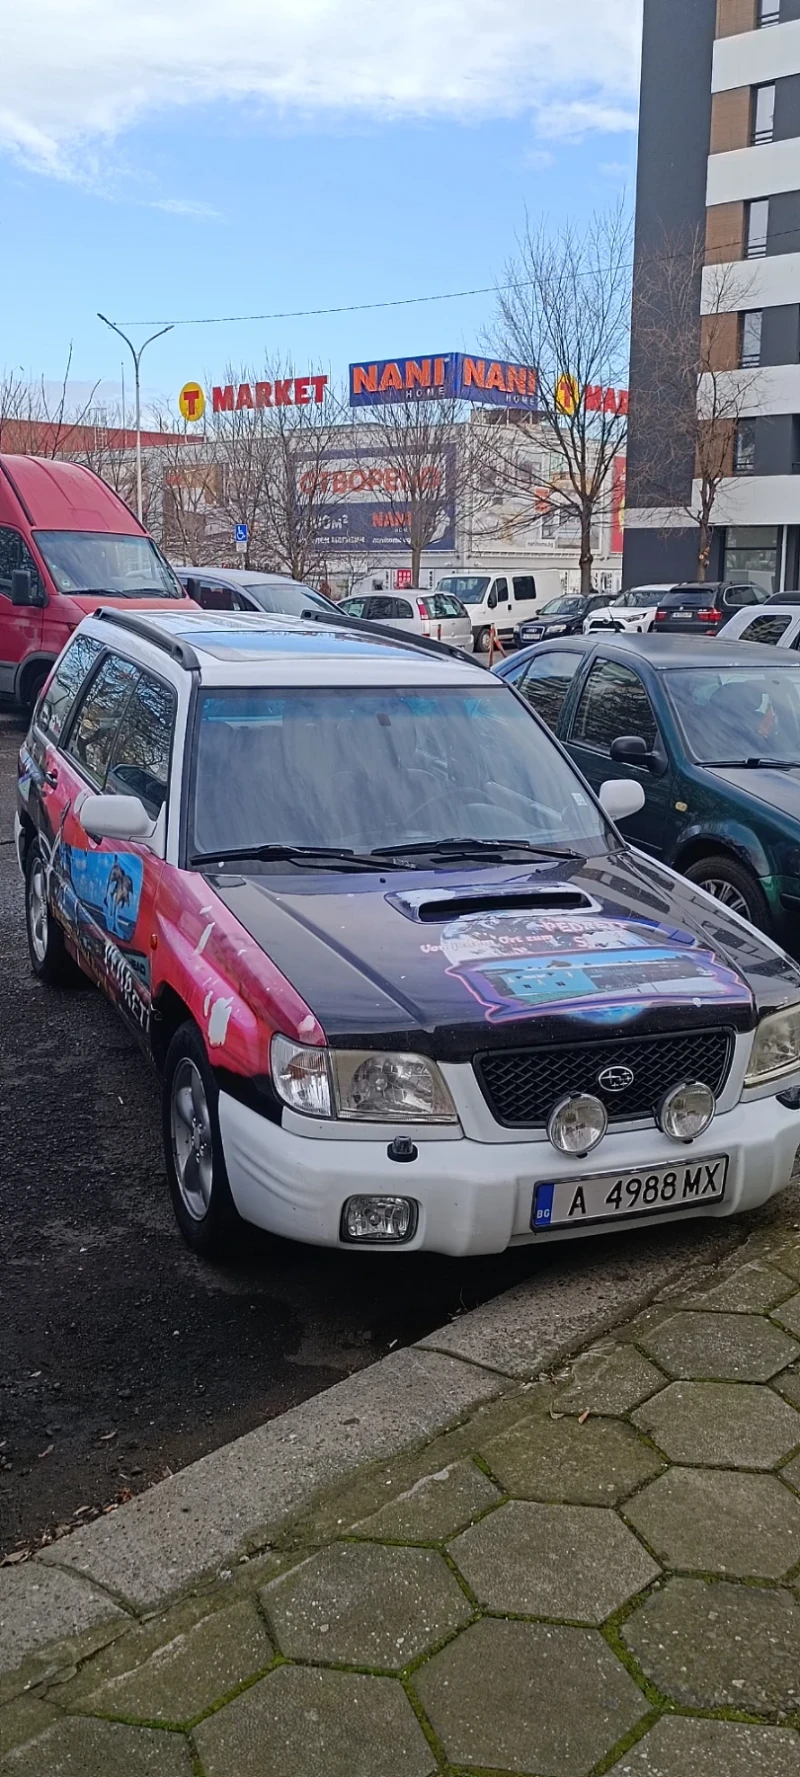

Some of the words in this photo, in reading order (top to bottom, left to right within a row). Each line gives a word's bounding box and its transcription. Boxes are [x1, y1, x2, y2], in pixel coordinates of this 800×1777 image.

[353, 357, 445, 394] NANI
[463, 357, 536, 395] NANI
[184, 390, 199, 416] T
[212, 375, 328, 412] MARKET
[406, 386, 446, 398] HOME
[506, 394, 535, 406] HOME
[372, 510, 412, 528] NANI
[498, 935, 523, 944] Ort
[567, 1186, 587, 1217] A
[605, 1171, 677, 1210] 4988
[682, 1163, 720, 1198] MX
[536, 1208, 550, 1219] BG
